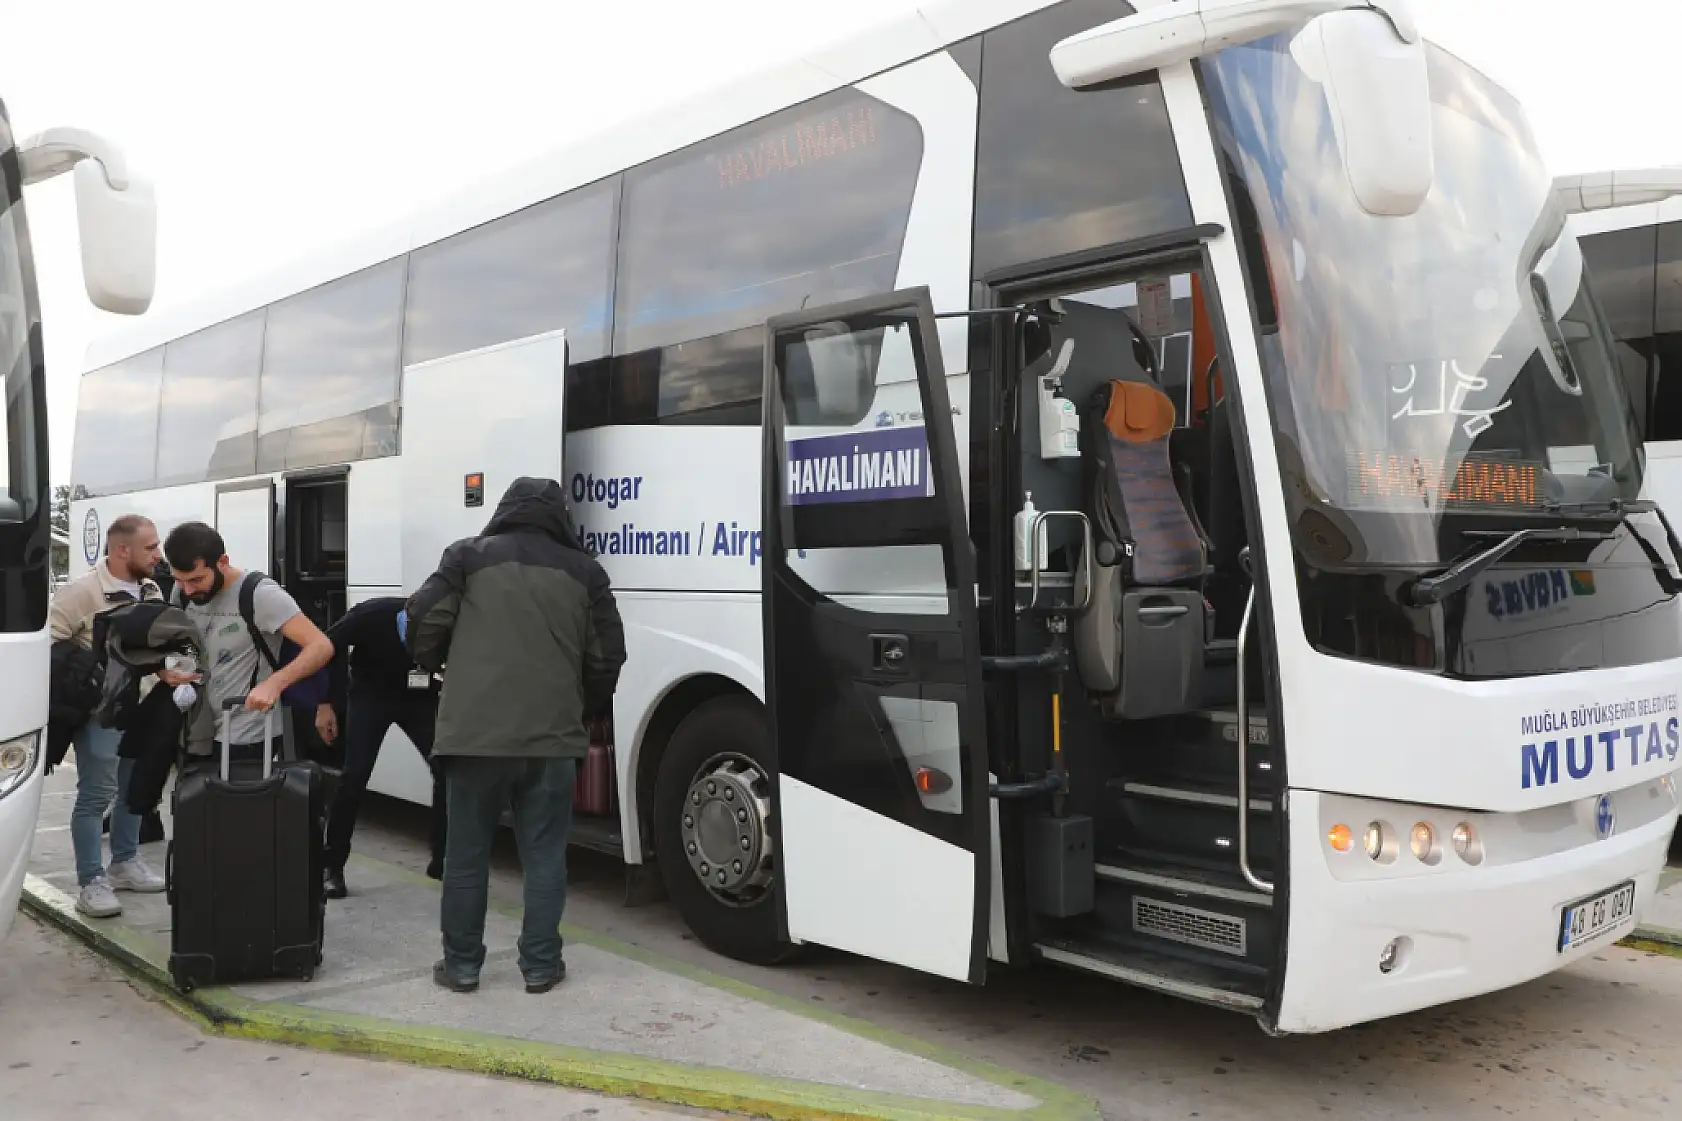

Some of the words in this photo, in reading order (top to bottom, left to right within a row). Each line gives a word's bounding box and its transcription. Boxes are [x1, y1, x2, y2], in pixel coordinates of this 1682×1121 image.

[787, 445, 920, 495] HAVALİMANI
[572, 473, 642, 509] Otogar
[697, 521, 705, 556] /
[1521, 710, 1568, 736] MUĞLA
[1571, 698, 1636, 728] BÜYÜKŞEHİR
[1521, 716, 1679, 790] MUTTAŞ
